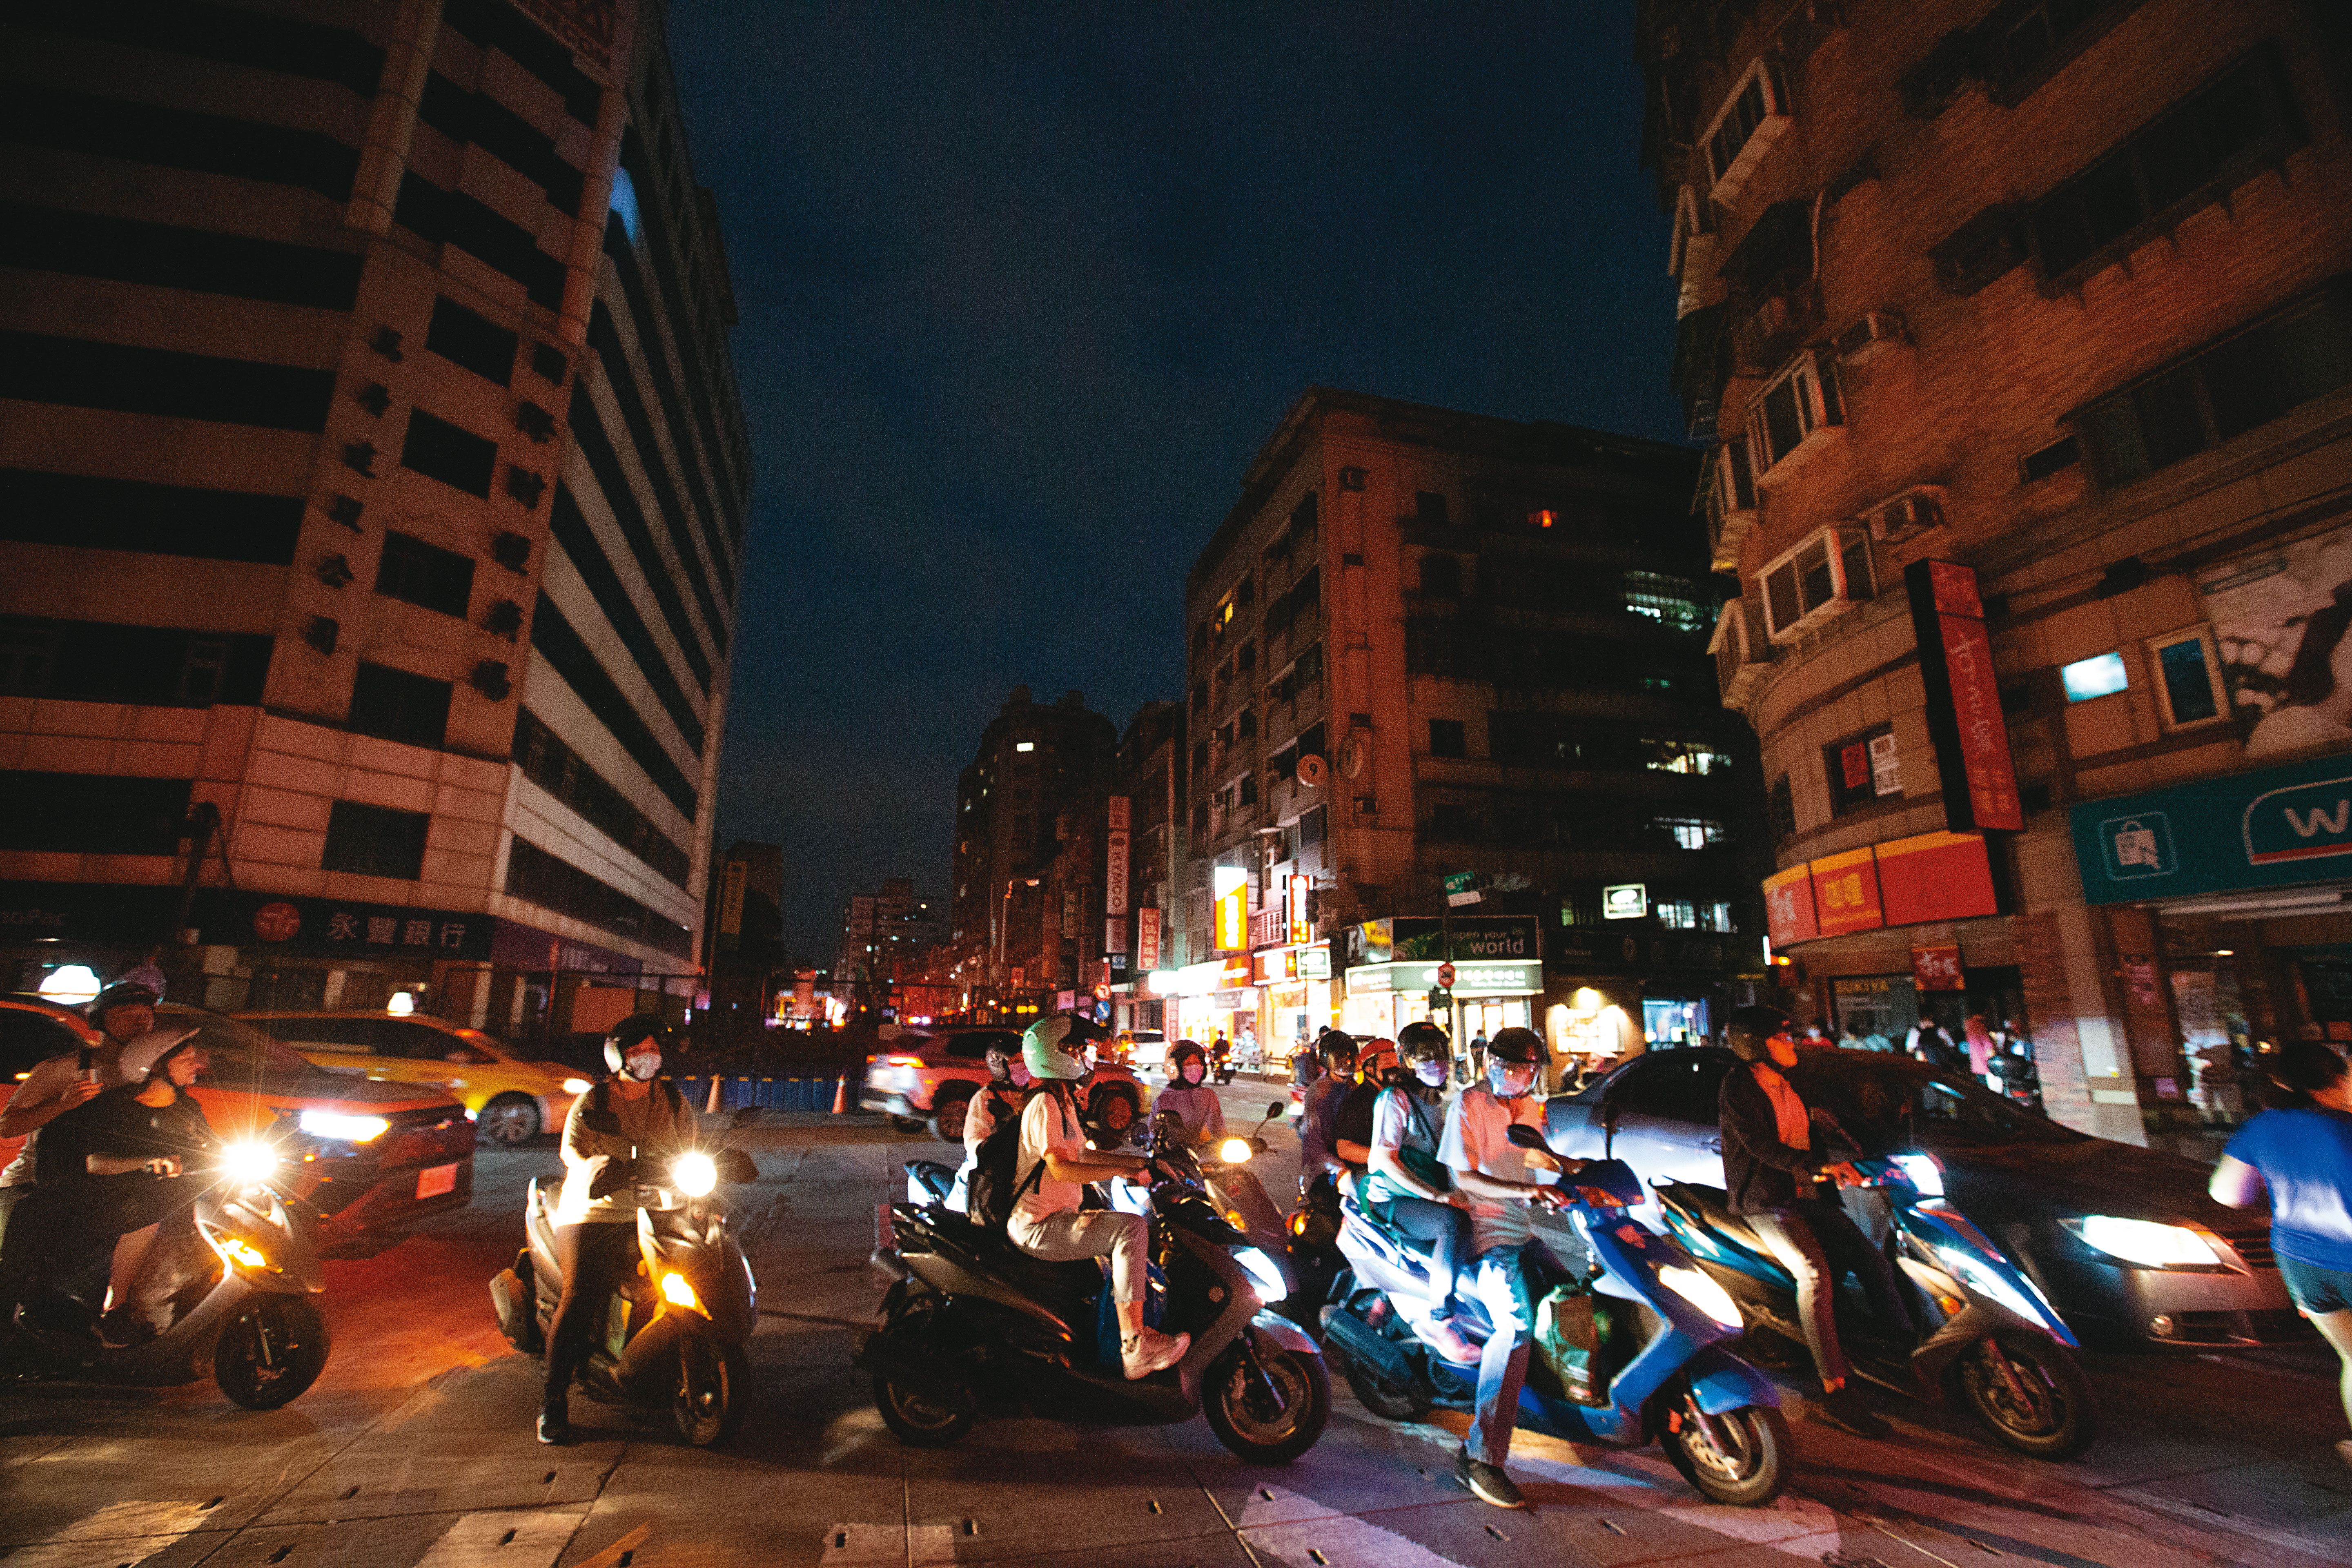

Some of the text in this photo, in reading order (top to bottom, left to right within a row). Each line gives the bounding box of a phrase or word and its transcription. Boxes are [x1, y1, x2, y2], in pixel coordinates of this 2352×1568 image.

[1309, 763, 1318, 776] 9
[1112, 852, 1122, 908] KYMCO
[1452, 931, 1507, 941] open your
[1470, 938, 1524, 954] world
